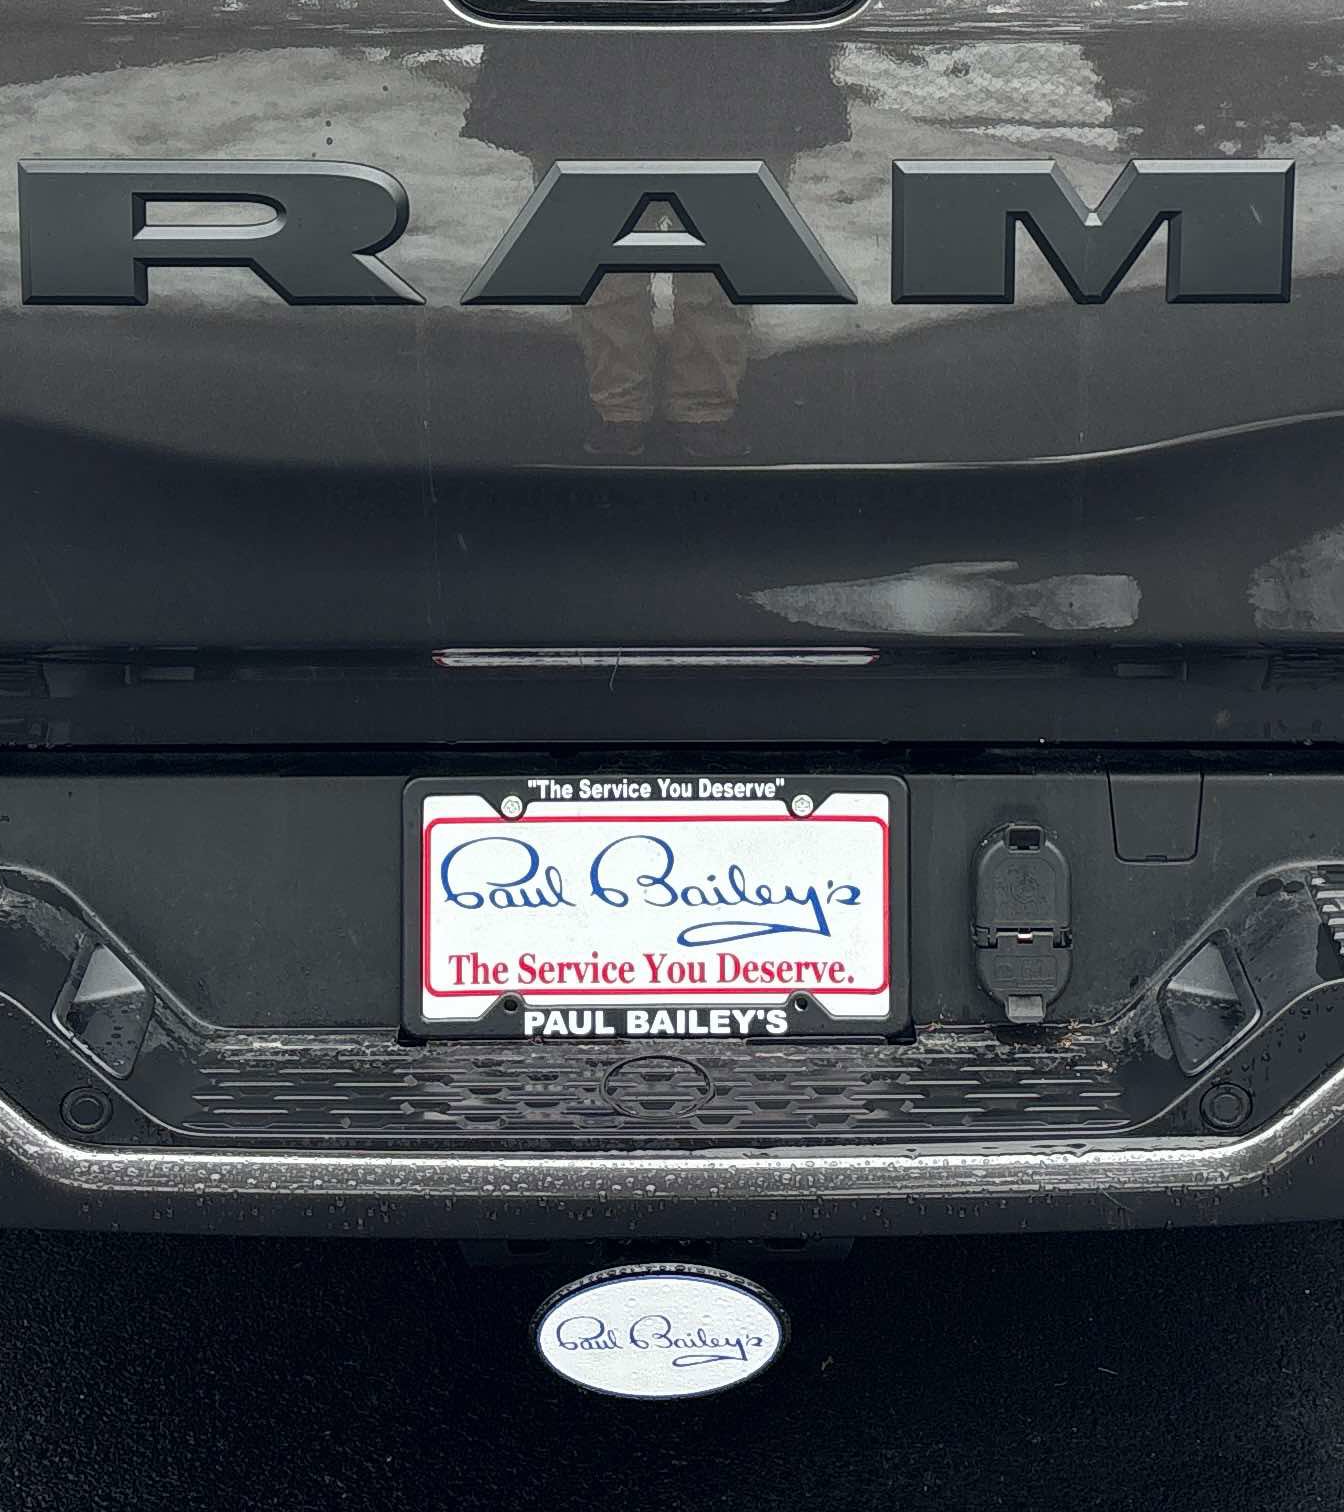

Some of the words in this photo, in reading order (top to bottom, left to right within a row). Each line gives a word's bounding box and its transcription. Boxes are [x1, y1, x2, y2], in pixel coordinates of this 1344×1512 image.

[18, 157, 1296, 305] RAM
[527, 778, 573, 800] "The
[578, 778, 652, 799] Service
[656, 778, 692, 798] You
[698, 777, 785, 798] Deserve"
[440, 836, 577, 910] Paul
[590, 834, 862, 947] Bailey's
[448, 951, 509, 986] The
[517, 951, 635, 985] Service
[642, 954, 707, 984] You
[718, 952, 856, 984] Deserve.
[523, 1010, 618, 1037] PAUL
[627, 1008, 789, 1035] BAILEY'S
[556, 1315, 624, 1351] Paul
[629, 1314, 763, 1368] Bailey's
